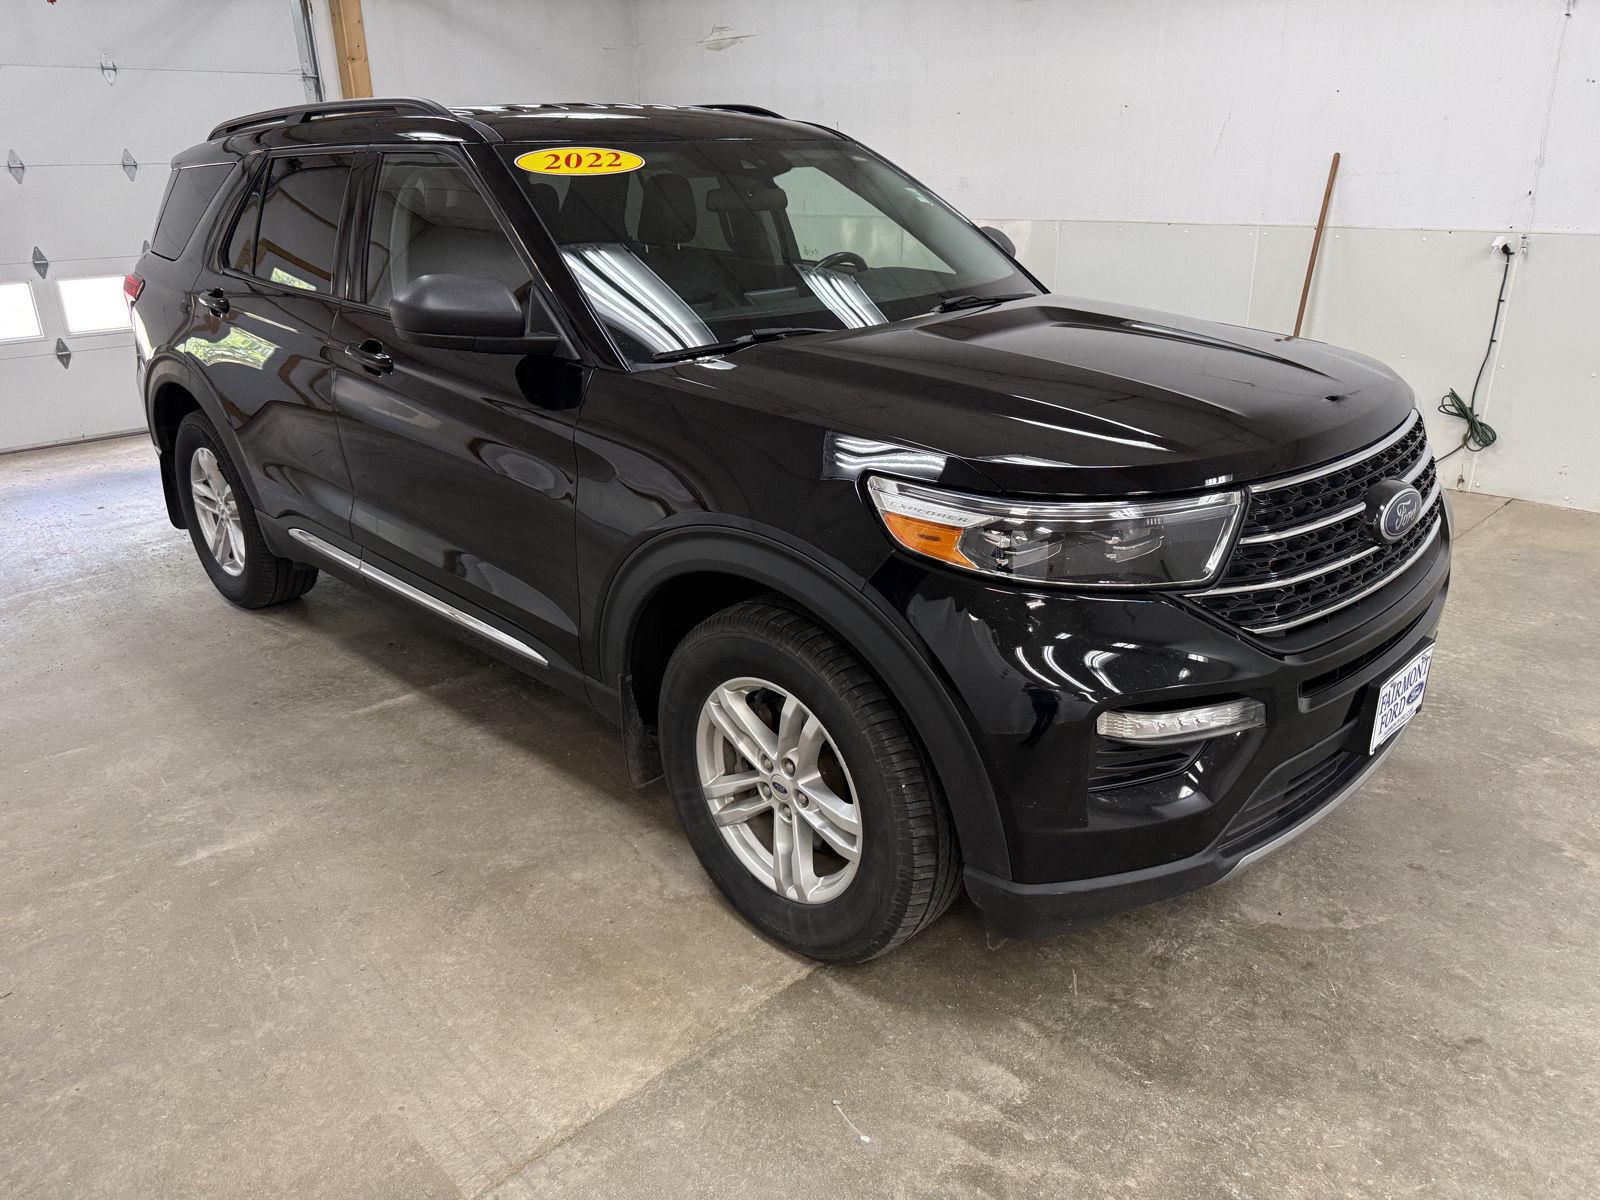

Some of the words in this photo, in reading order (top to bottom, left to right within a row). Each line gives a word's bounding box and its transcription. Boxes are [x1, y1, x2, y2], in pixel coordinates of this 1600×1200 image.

[544, 152, 622, 170] 2022
[1395, 499, 1417, 530] Ford
[1379, 655, 1431, 715] FAIRMONT
[1378, 695, 1406, 735] FORD
